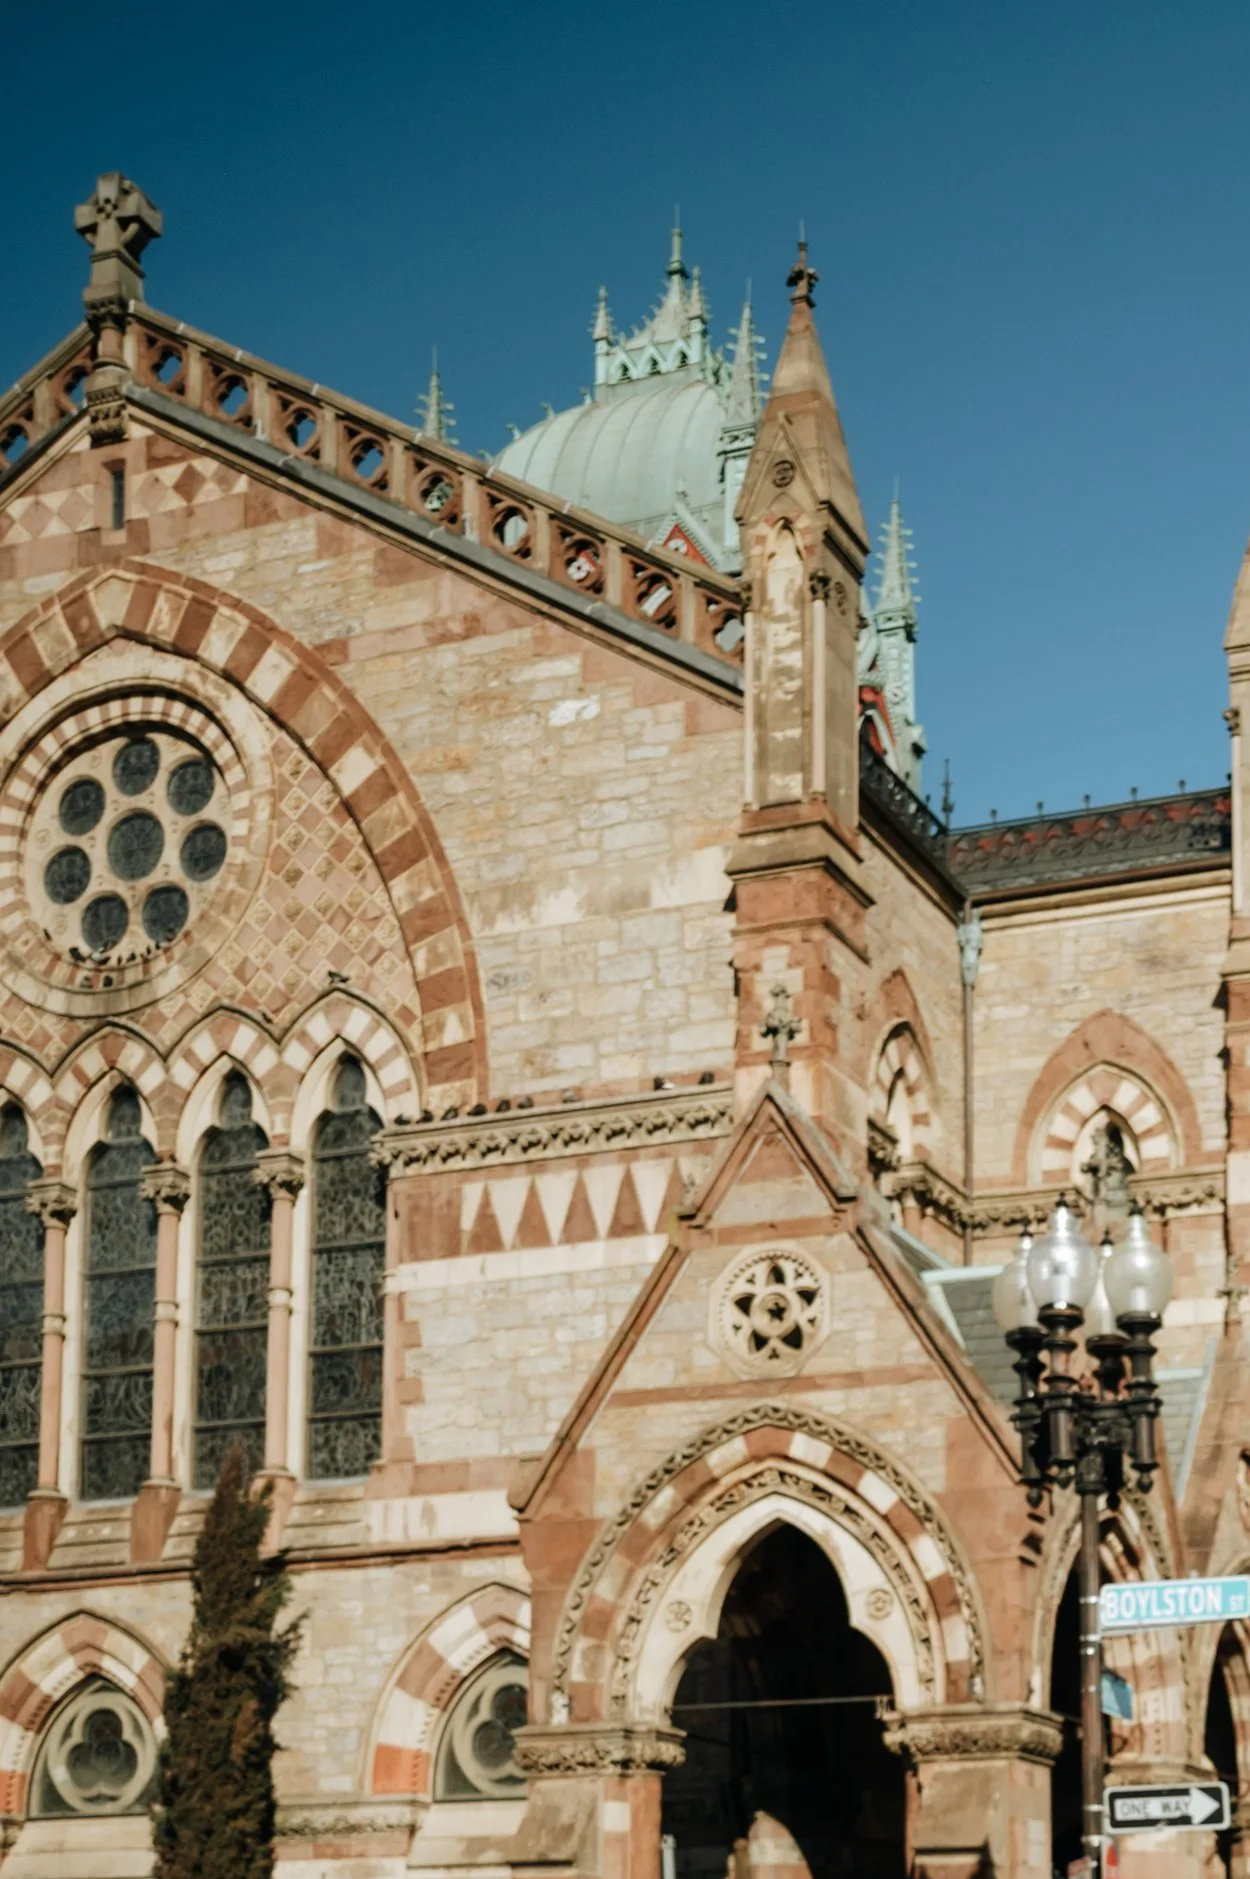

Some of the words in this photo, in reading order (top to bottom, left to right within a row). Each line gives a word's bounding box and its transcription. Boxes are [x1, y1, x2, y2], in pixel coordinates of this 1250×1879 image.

[1105, 1585, 1222, 1619] BOYLSTON
[1120, 1799, 1148, 1817] ONE
[1161, 1798, 1191, 1813] WAY
